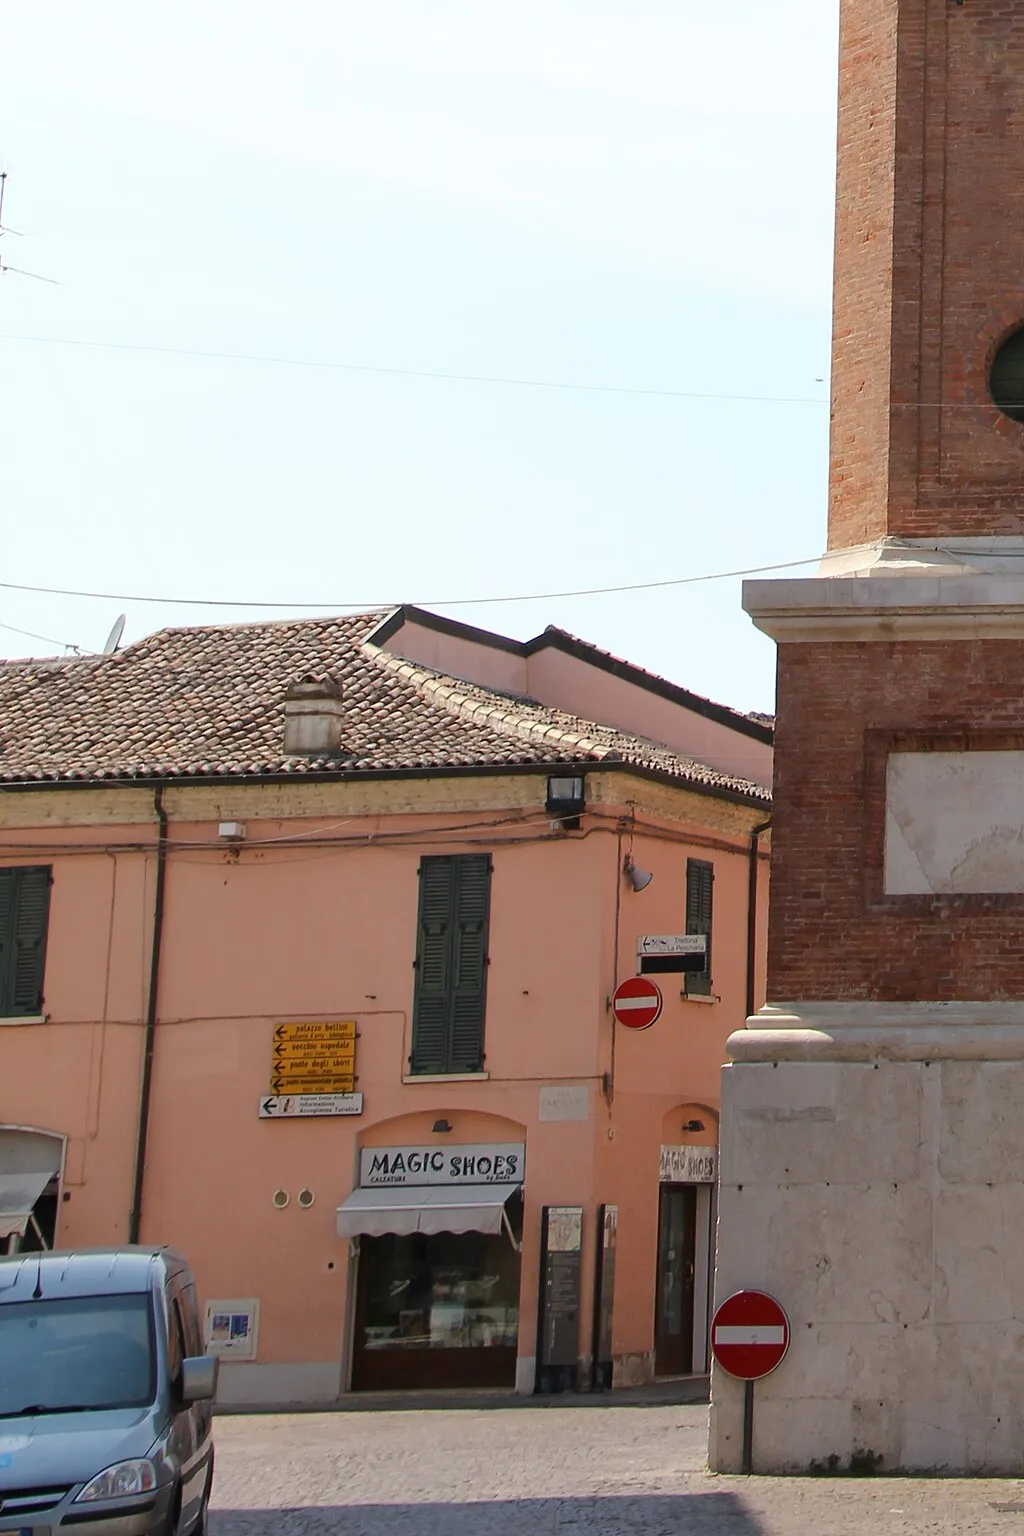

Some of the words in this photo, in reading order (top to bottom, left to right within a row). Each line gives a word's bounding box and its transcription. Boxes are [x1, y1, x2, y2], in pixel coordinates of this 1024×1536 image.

[296, 1024, 321, 1033] palazzo
[292, 1042, 317, 1050] vecchio
[320, 1040, 350, 1051] ospedale
[289, 1061, 308, 1071] ponte
[311, 1059, 329, 1069] degli
[332, 1059, 351, 1067] sbirri
[368, 1151, 444, 1176] MAGIC
[449, 1155, 518, 1177] SHOES
